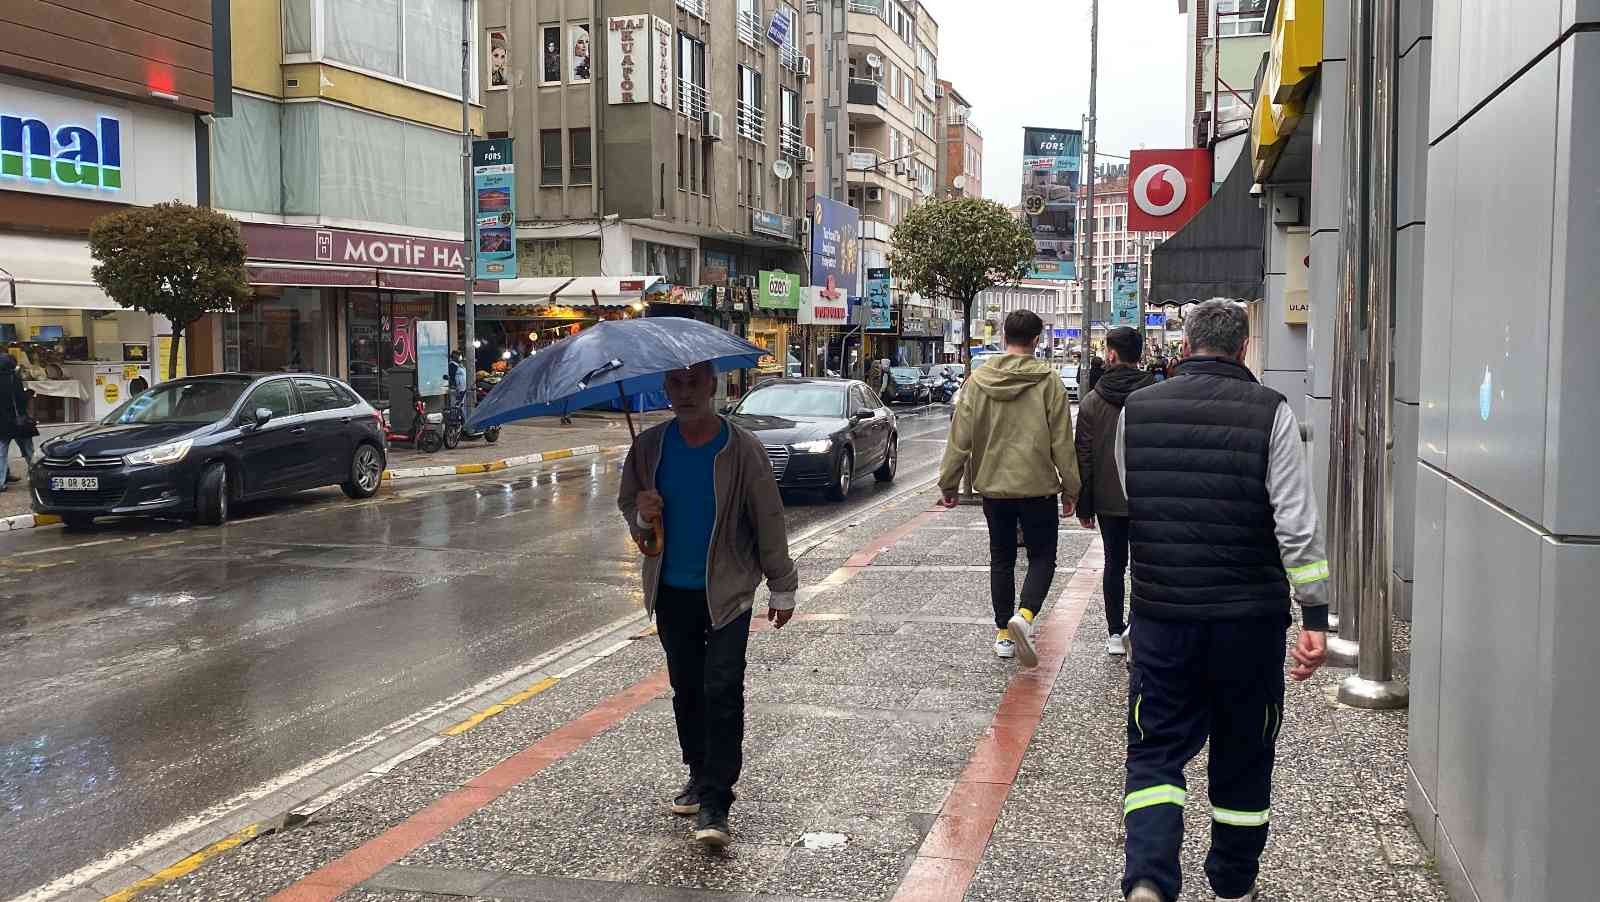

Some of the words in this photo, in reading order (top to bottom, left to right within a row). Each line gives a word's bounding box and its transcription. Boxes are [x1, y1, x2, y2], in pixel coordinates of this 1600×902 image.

[1, 115, 121, 188] nal
[1040, 142, 1064, 150] FORS
[344, 239, 425, 265] MOTİF
[433, 247, 464, 268] HA
